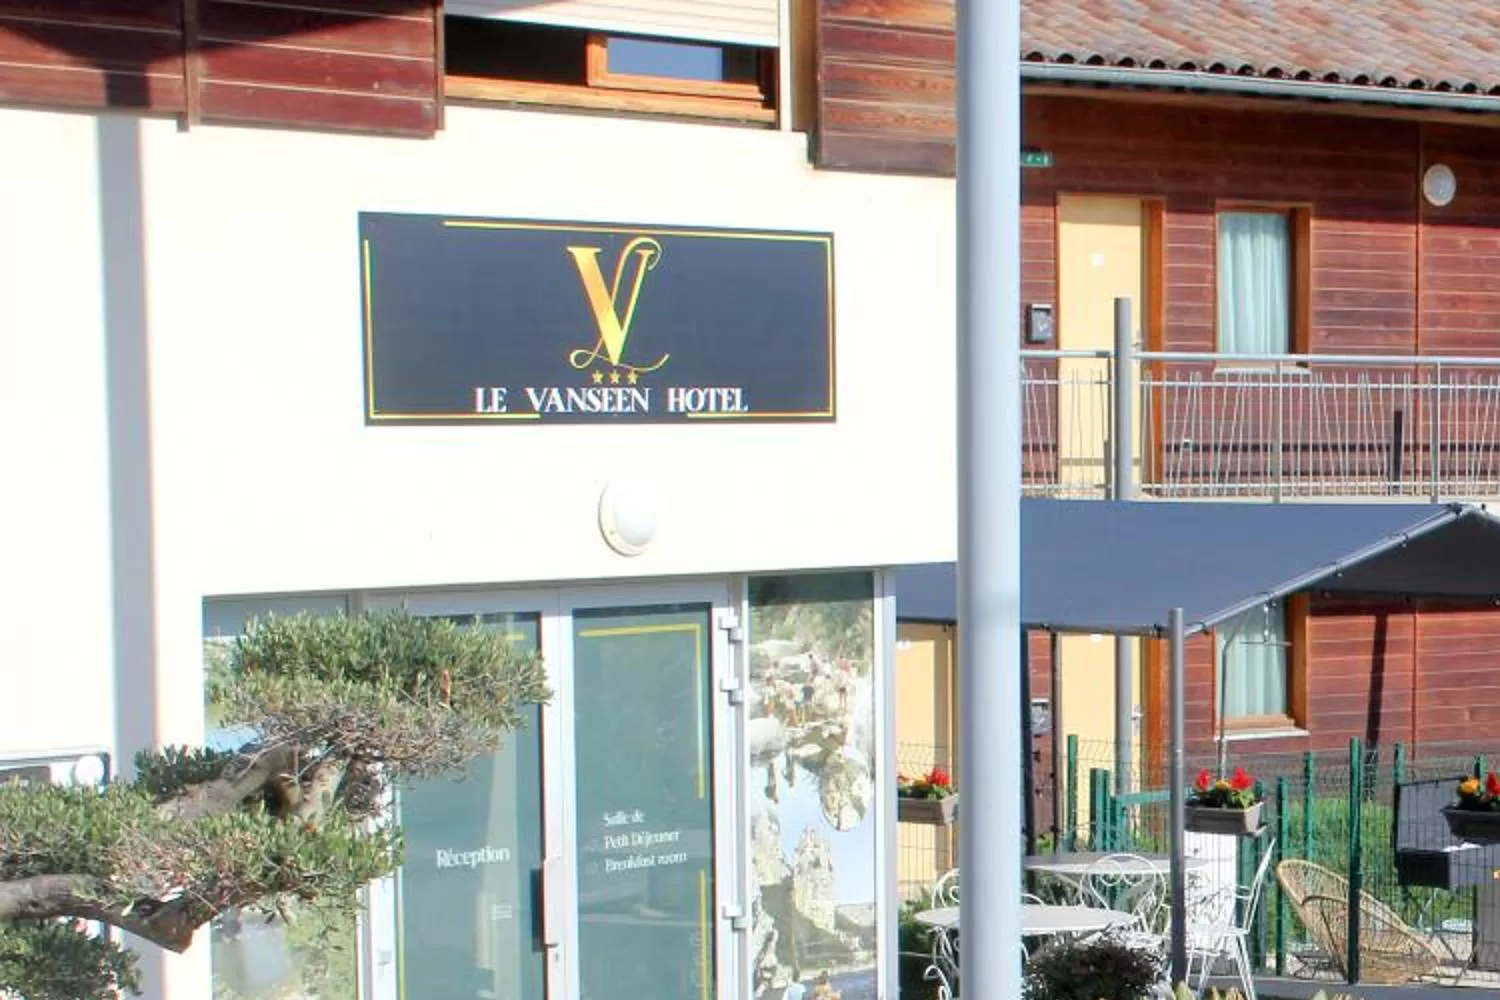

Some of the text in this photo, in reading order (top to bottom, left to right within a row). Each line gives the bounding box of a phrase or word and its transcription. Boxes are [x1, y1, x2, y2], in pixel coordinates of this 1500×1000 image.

[475, 386, 749, 413] LE VANSEEN HOTEL
[603, 807, 646, 827] Salle de
[603, 830, 680, 849] Petit Déjeuner
[435, 845, 510, 869] Réception
[605, 851, 688, 873] Breakfast room
